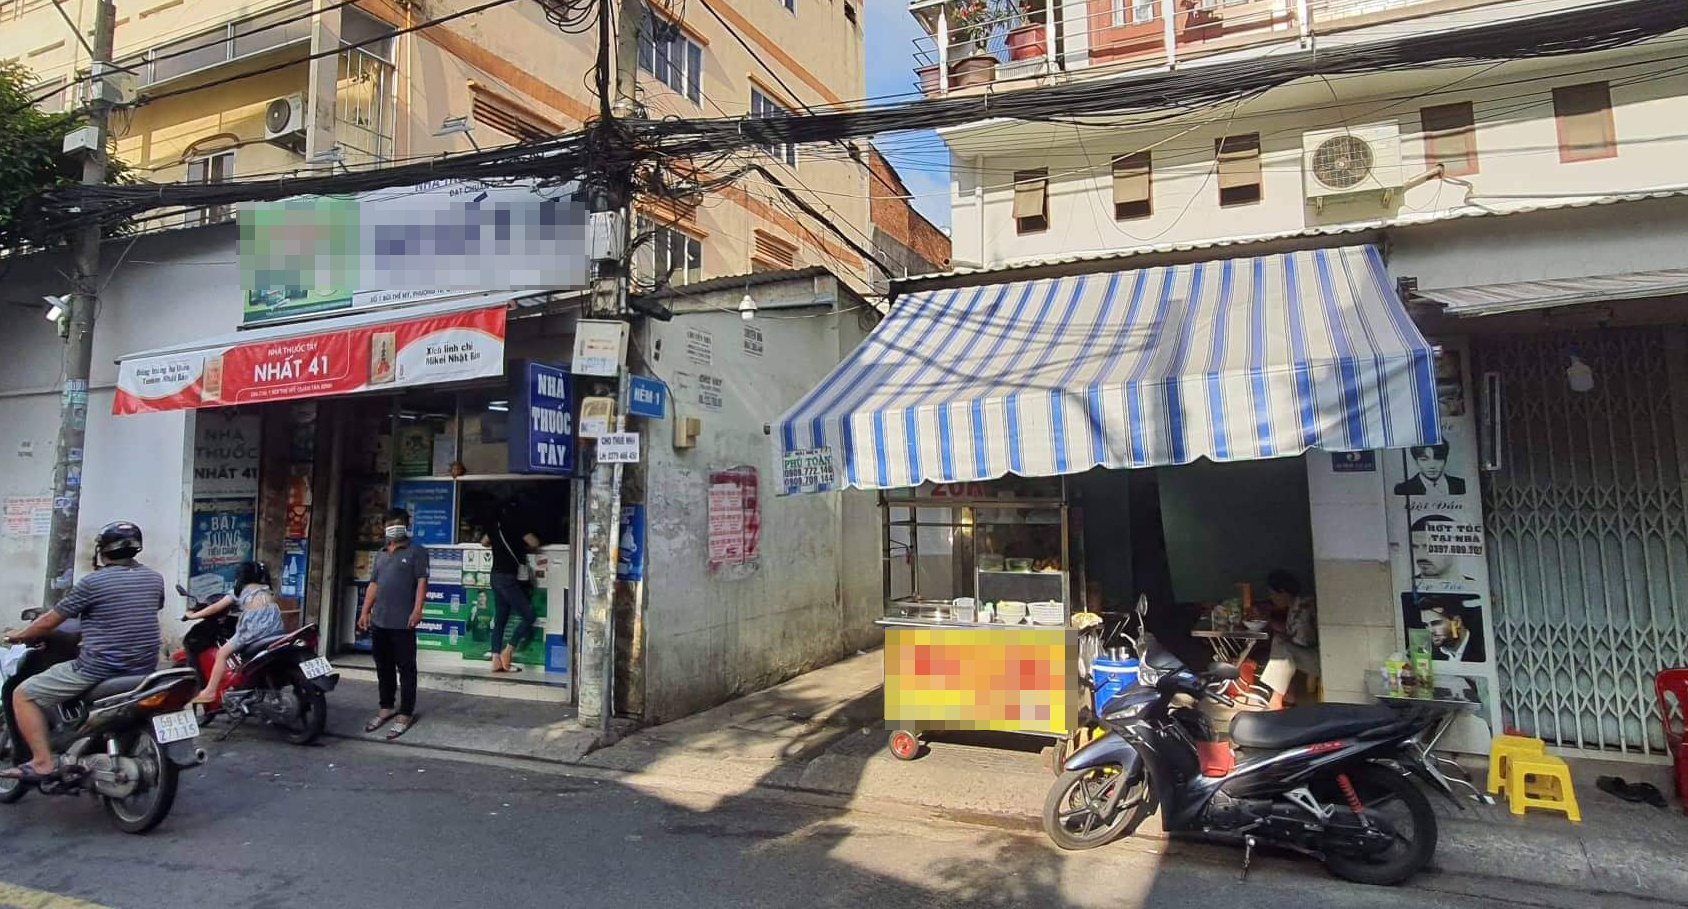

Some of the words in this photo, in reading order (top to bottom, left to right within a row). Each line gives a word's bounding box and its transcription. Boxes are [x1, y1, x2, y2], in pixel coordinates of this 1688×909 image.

[268, 348, 282, 357] NHÀ
[283, 344, 305, 355] THUỐC
[444, 343, 459, 353] linh
[461, 341, 473, 351] chi
[448, 353, 469, 363] Nhật
[254, 354, 303, 383] NHẤT
[308, 355, 329, 376] 41
[537, 373, 565, 399] NHÀ
[655, 392, 660, 405] 1
[531, 402, 571, 436] THUỐC
[601, 437, 611, 445] CHO
[196, 443, 259, 459] THUỐC
[194, 463, 239, 479] NHẤT
[242, 467, 258, 479] 41
[1456, 523, 1482, 533] TÓC
[1456, 533, 1481, 543] NHÀ
